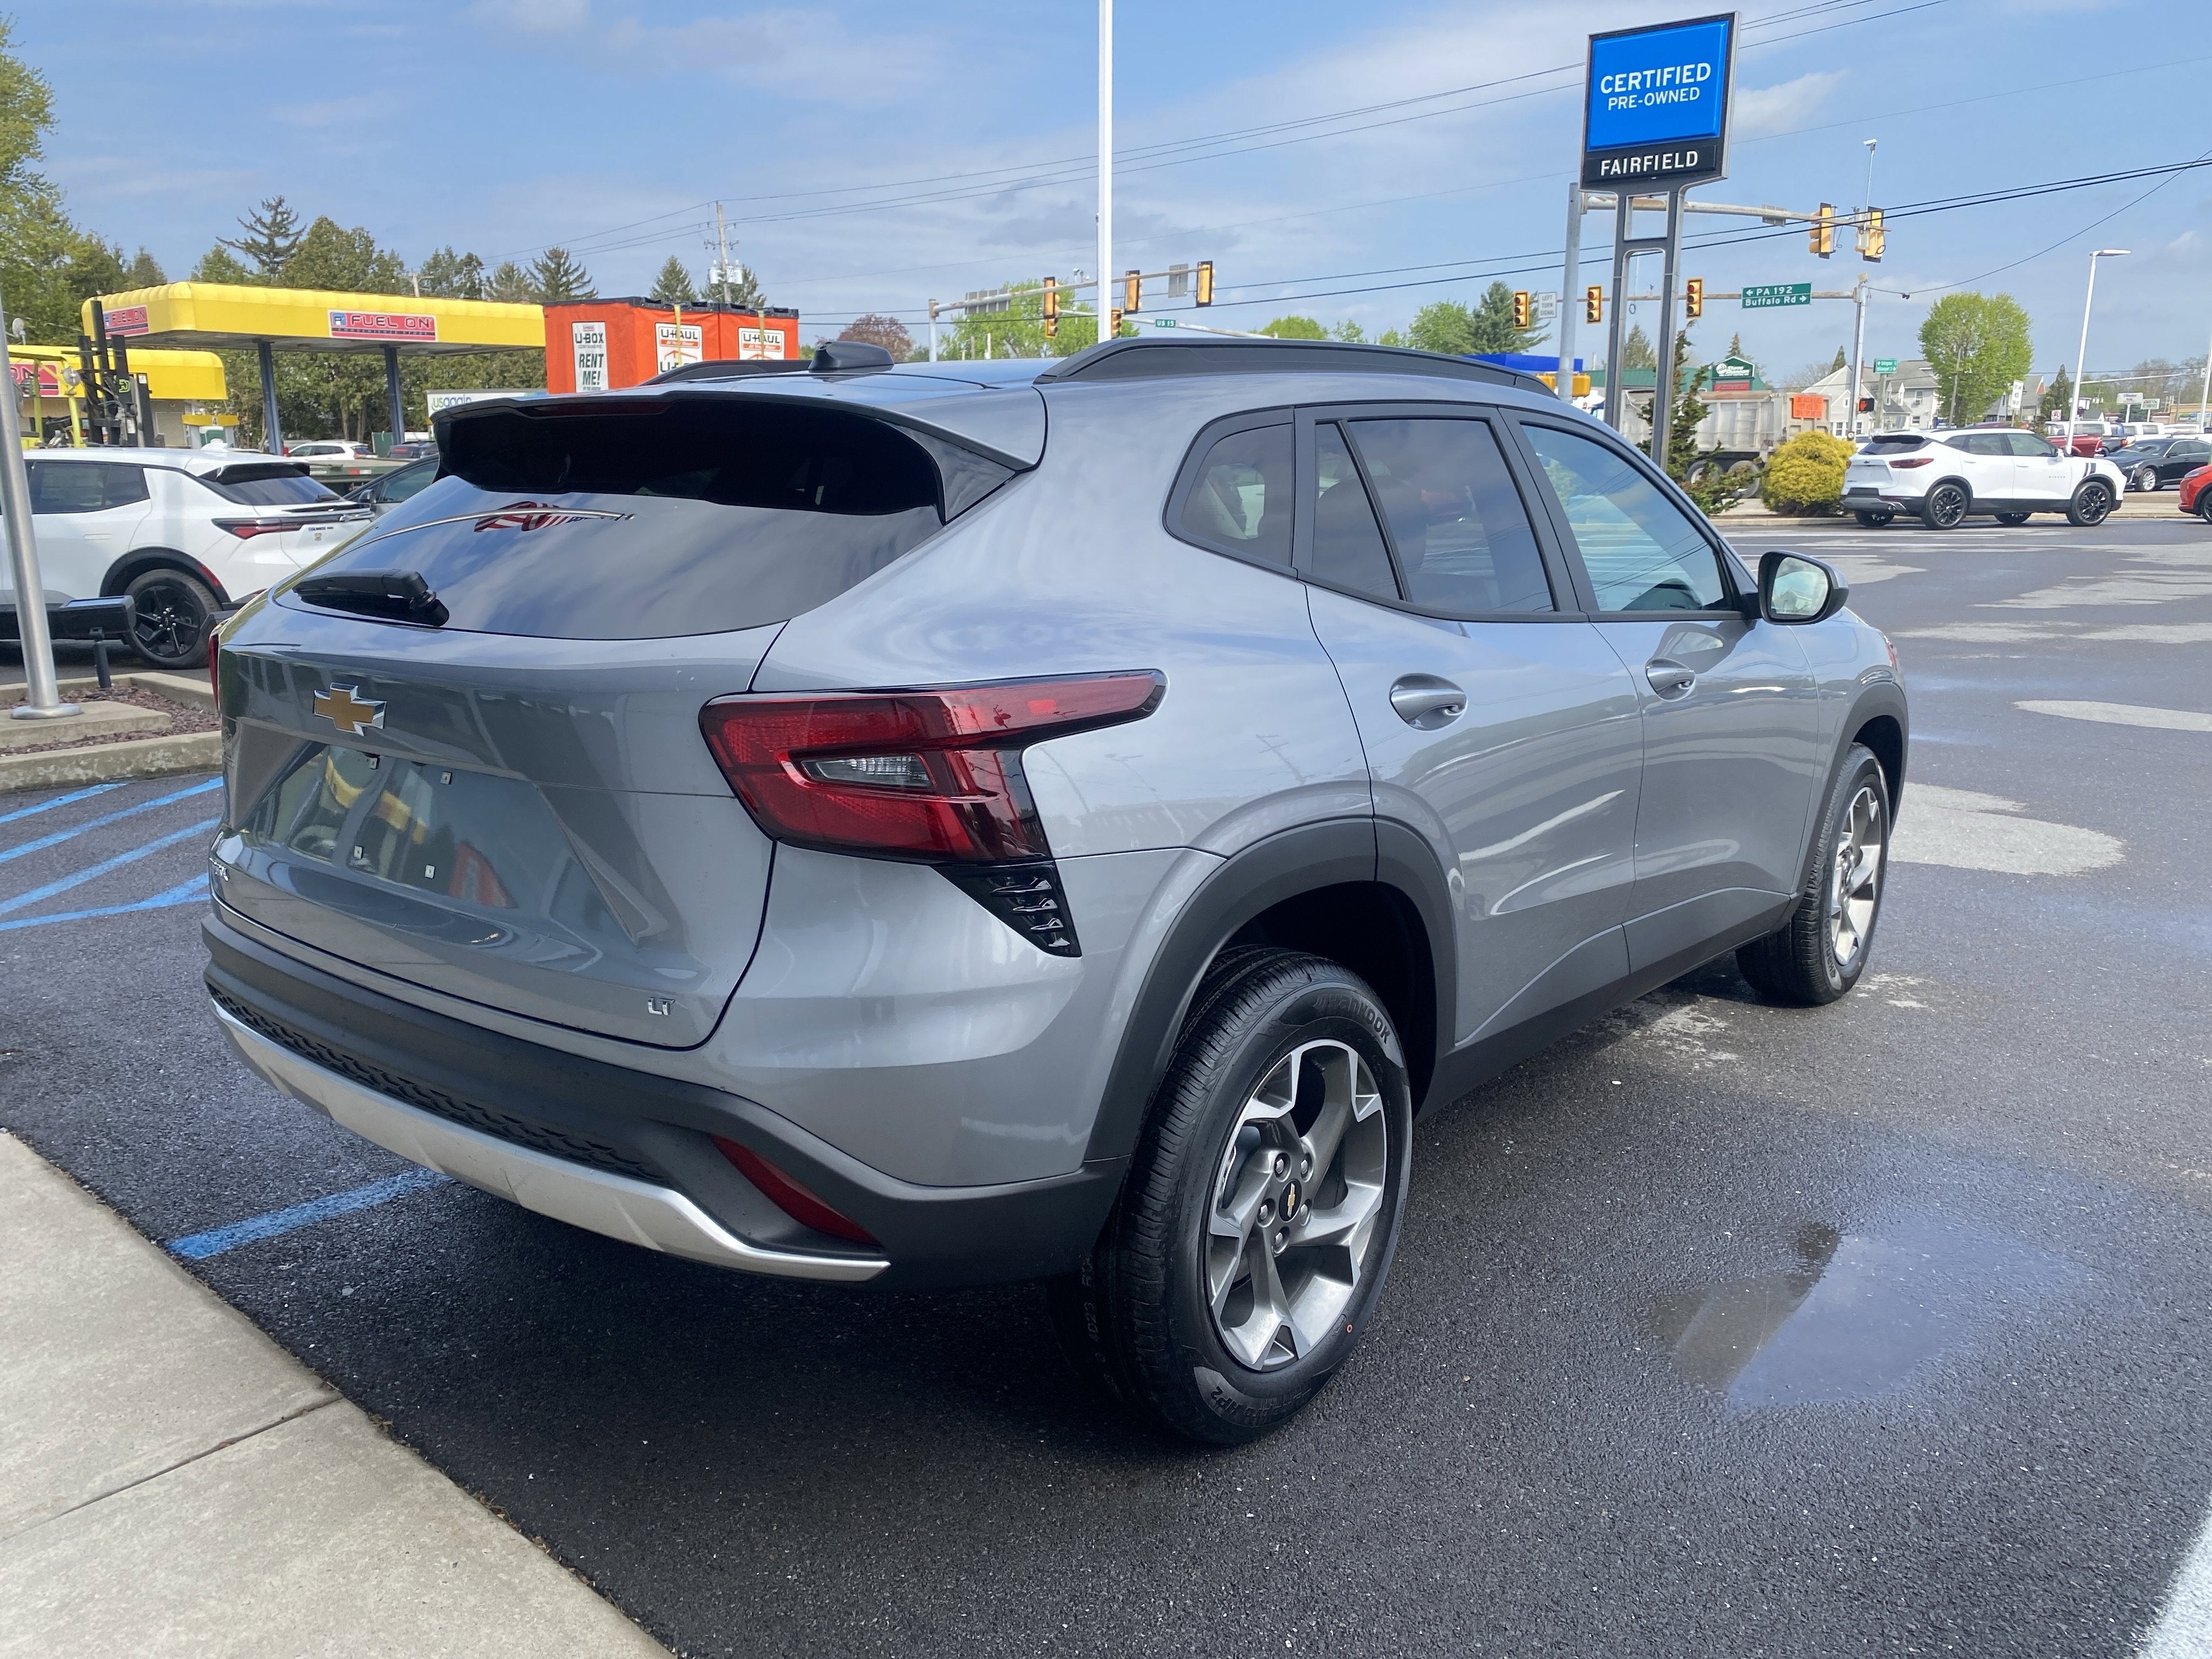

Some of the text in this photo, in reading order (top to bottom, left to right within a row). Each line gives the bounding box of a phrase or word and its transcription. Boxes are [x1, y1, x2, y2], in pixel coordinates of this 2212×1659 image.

[1600, 63, 1711, 94] CERTIFIED
[1608, 87, 1700, 111] PRE-OWNED
[1601, 150, 1699, 176] FAIRFIELD
[1774, 286, 1793, 295] 192
[1745, 297, 1780, 306] Buffalo
[111, 308, 146, 325] FUEL ON
[351, 315, 431, 329] FUEL ON
[575, 332, 604, 343] U-BOX
[579, 353, 604, 368] RENT
[583, 370, 601, 385] ME!
[648, 997, 675, 1016] LT
